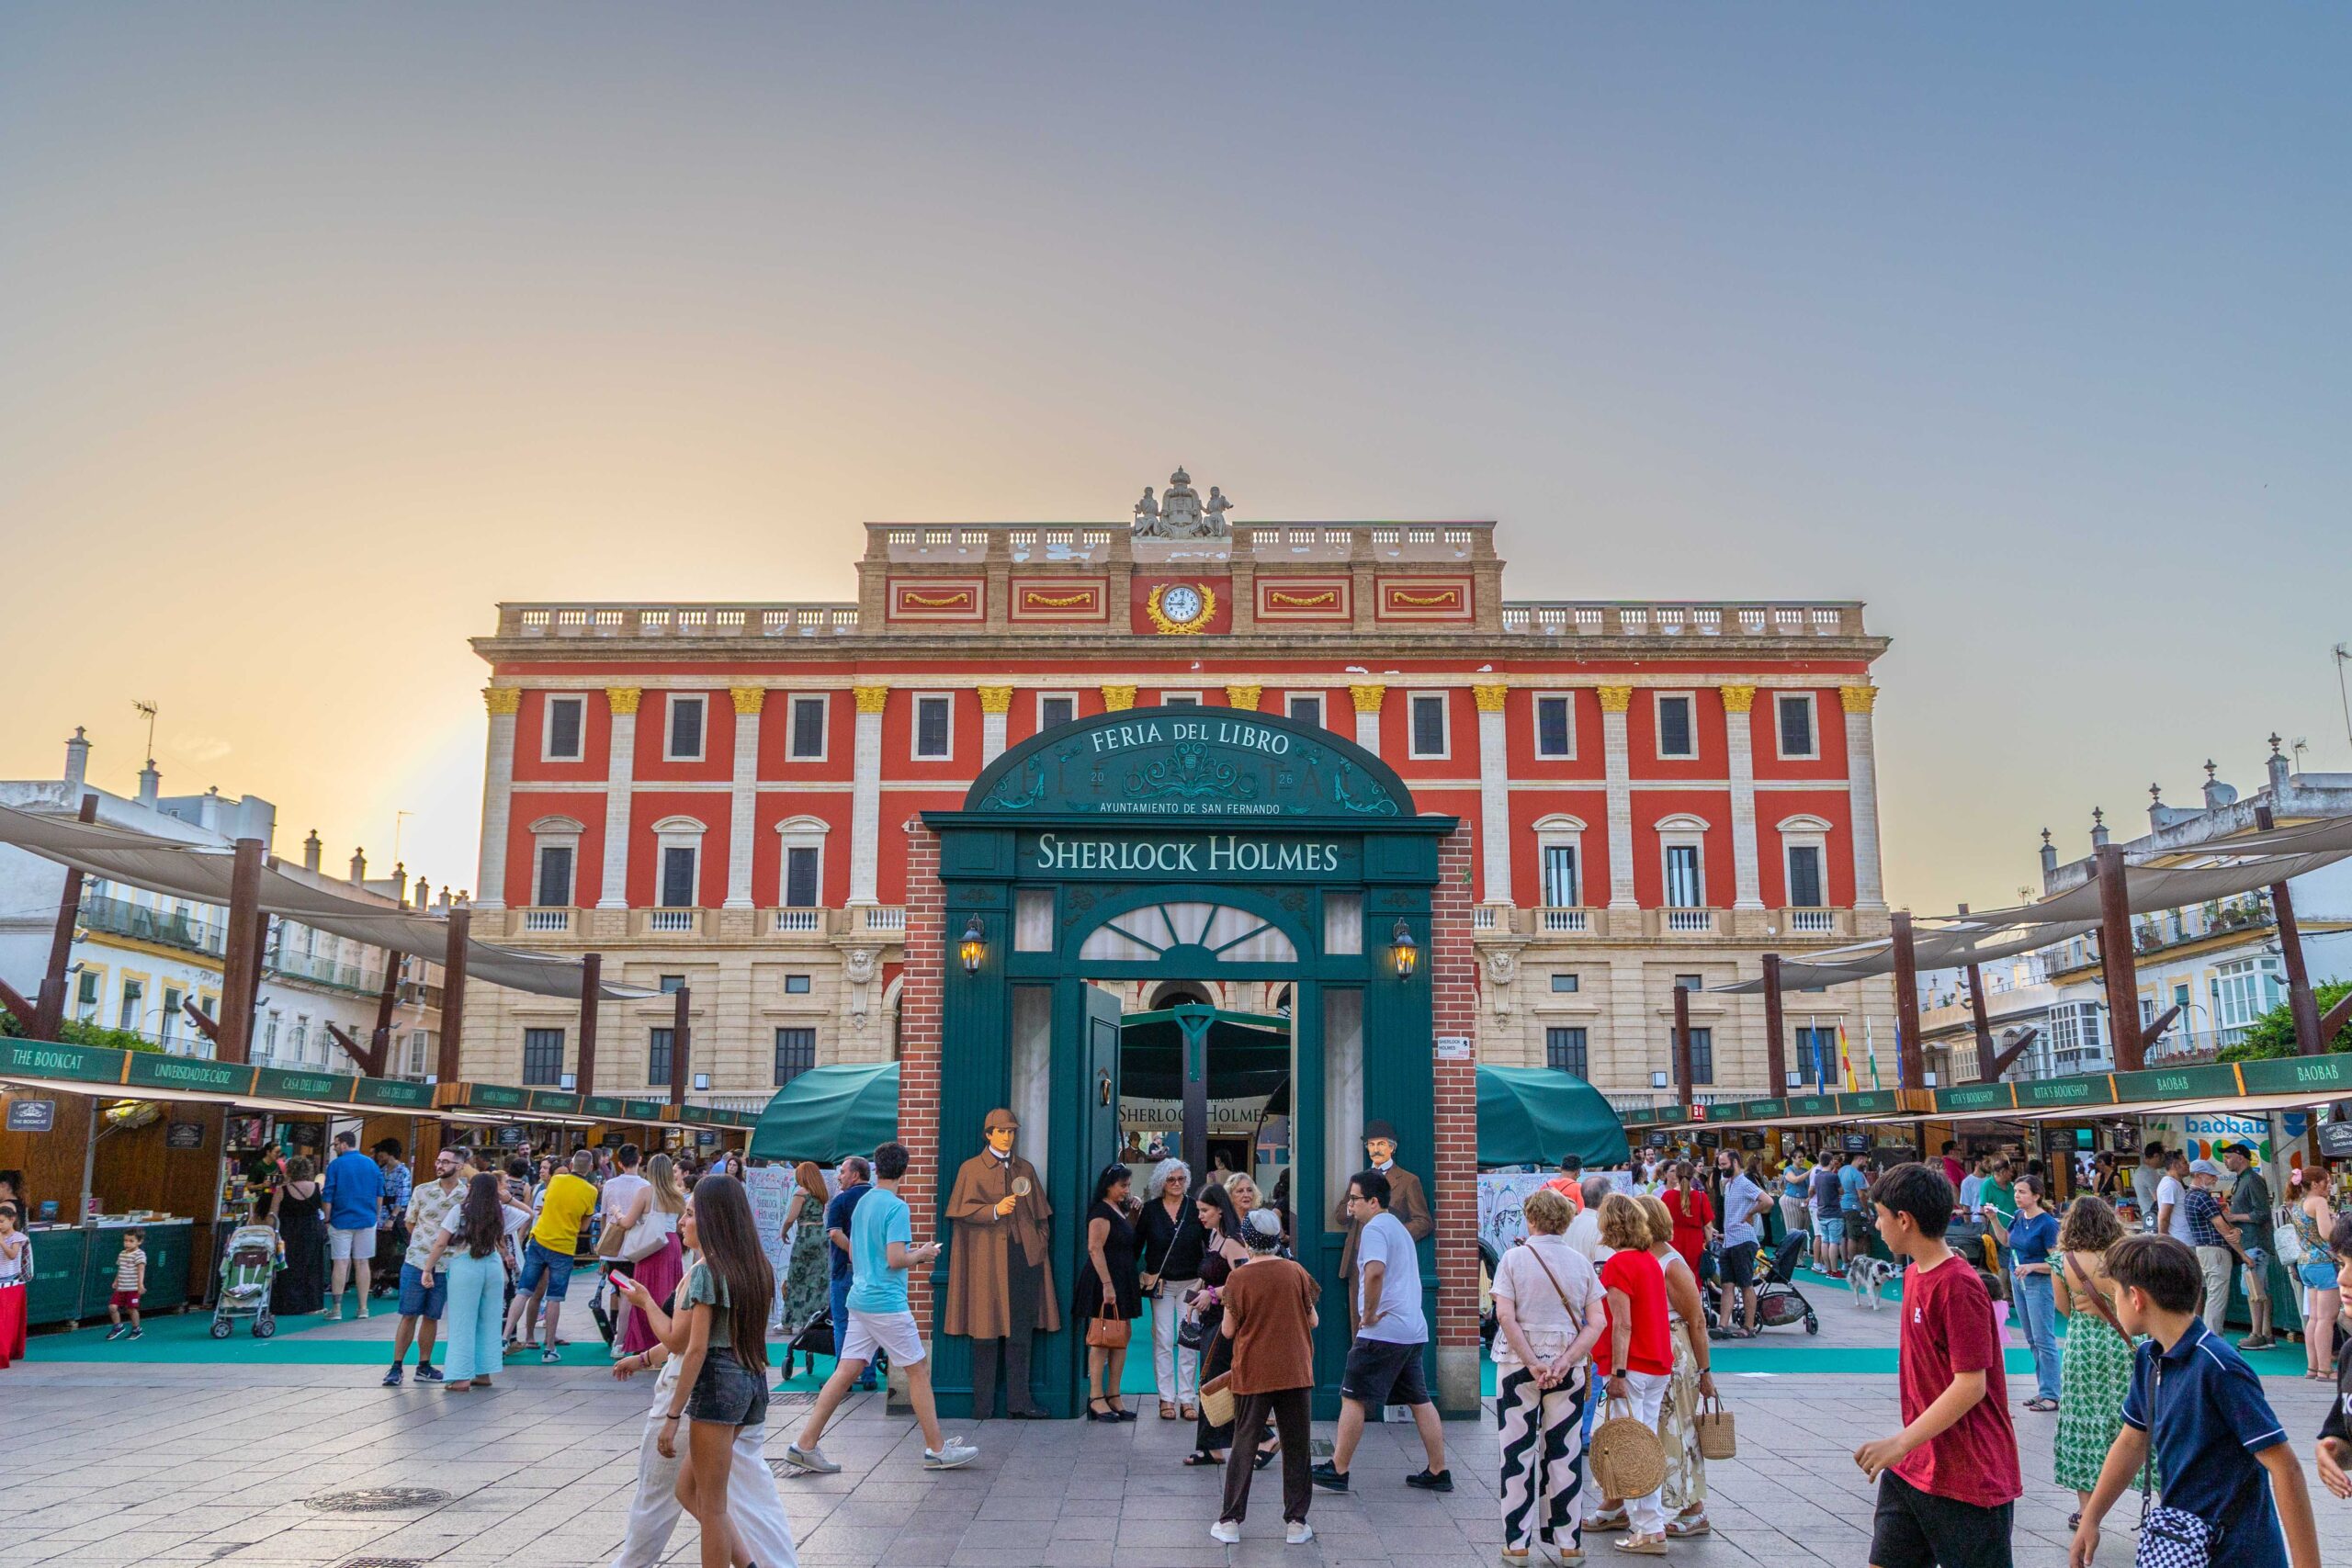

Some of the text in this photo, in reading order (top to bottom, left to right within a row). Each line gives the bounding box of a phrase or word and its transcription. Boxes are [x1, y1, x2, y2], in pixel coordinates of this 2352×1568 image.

[1091, 722, 1289, 755] FERIA DEL LIBRO
[1091, 772, 1104, 782] 20
[1279, 773, 1293, 784] 26
[1100, 802, 1280, 815] AYUNTAMIENTO DE SAN FERNANDO
[1037, 832, 1339, 872] SHERLOCK HOLMES
[13, 1049, 84, 1070] THE BOOKCAT
[154, 1063, 199, 1082] UNIVERSIDAD
[209, 1066, 232, 1084] CÁDIZ
[2297, 1064, 2339, 1082] BAOBAB
[282, 1077, 332, 1093] CASA DEL LIBRO
[2156, 1076, 2188, 1091] BAOBAB
[377, 1086, 390, 1097] CASA
[390, 1087, 401, 1099] DEL
[1950, 1090, 1994, 1105] RITA'S BOOKSHOP
[2033, 1084, 2088, 1100] RITA'S BOOKSHOP
[1118, 1104, 1183, 1122] SHERLOC
[2185, 1115, 2268, 1134] baobab
